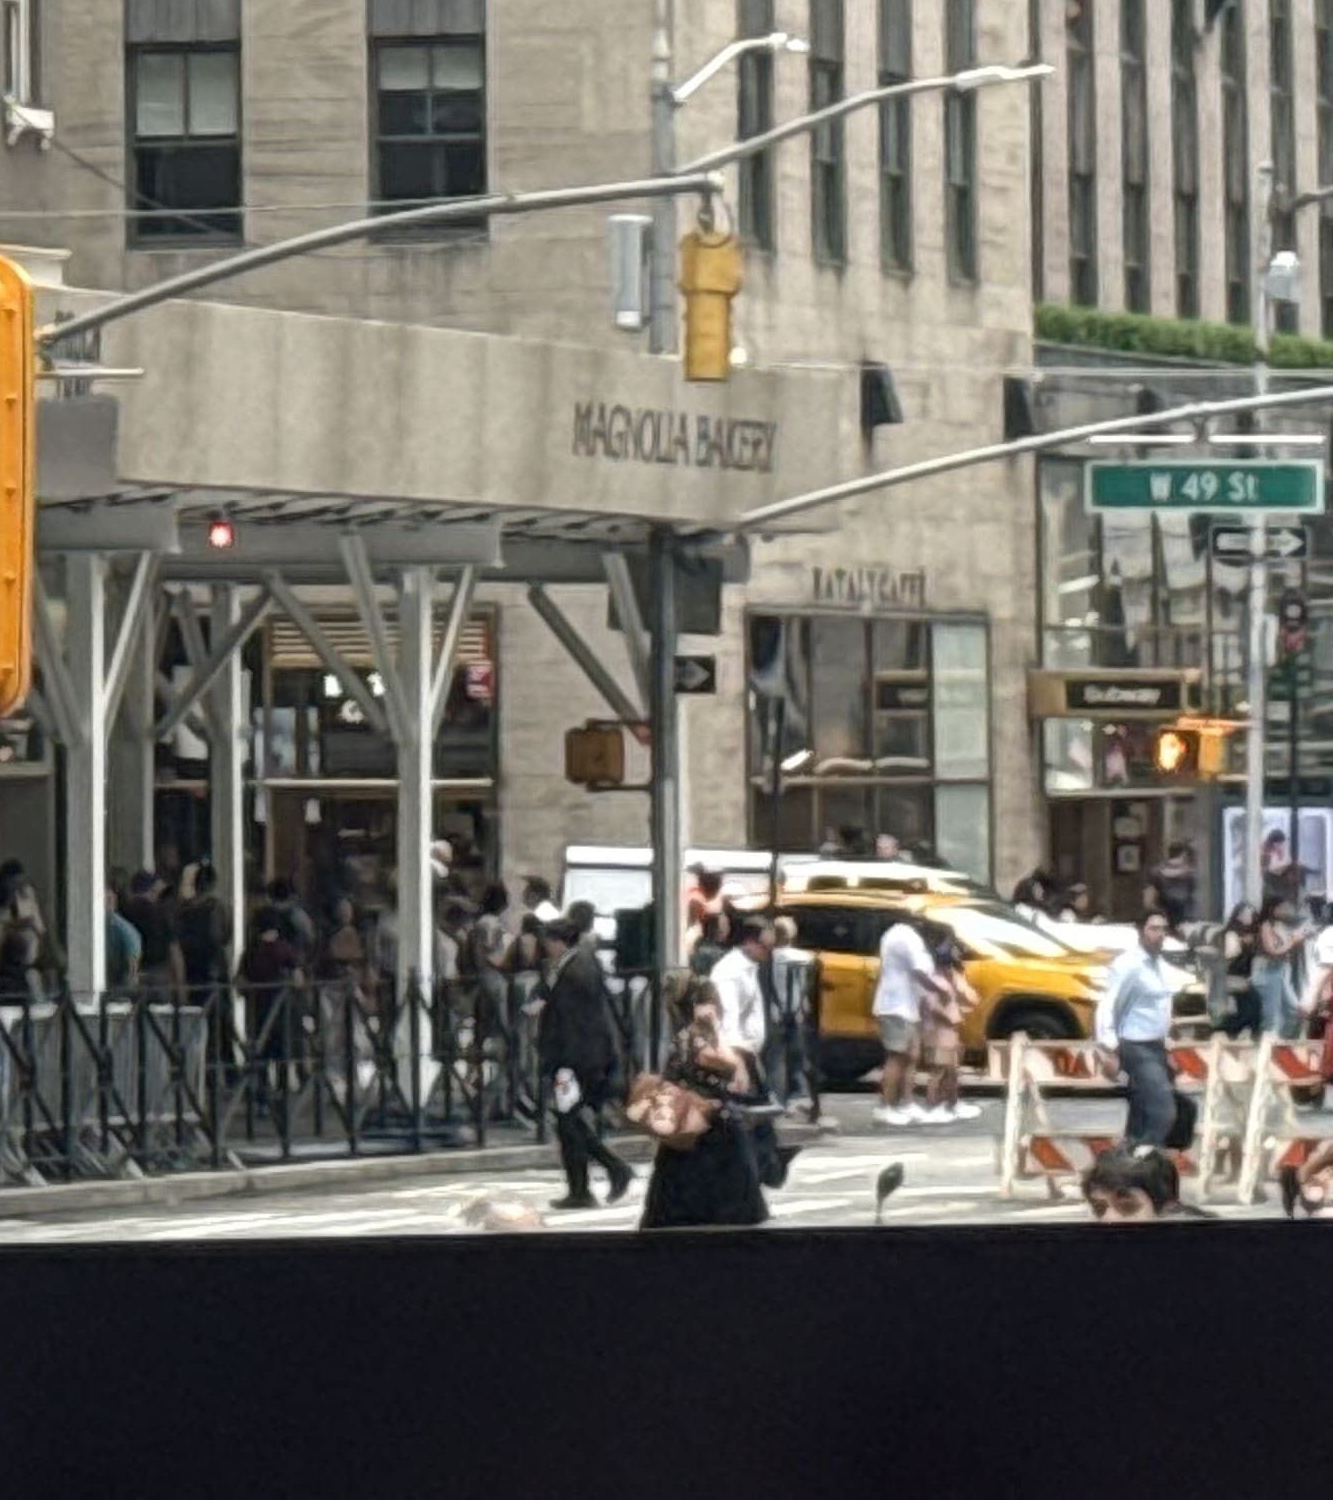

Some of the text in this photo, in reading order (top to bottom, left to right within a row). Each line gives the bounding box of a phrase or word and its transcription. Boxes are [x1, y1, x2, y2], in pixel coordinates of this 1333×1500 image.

[572, 401, 690, 468] MAGNOLIA
[1149, 470, 1260, 501] W 49 St
